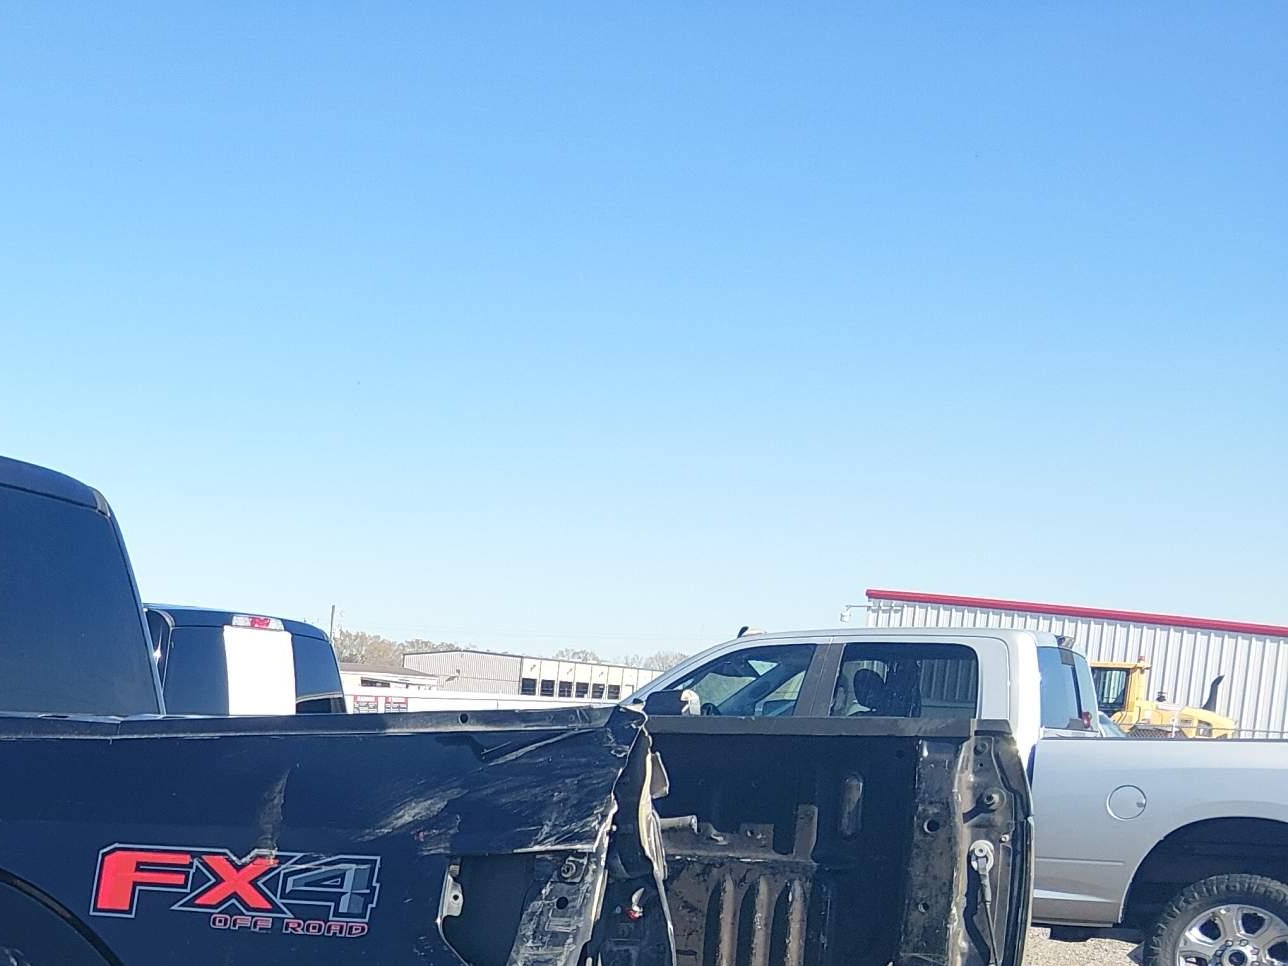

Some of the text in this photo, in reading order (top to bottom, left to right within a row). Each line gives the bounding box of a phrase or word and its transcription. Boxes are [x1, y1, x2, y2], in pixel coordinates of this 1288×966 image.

[89, 842, 381, 923] FX4
[209, 914, 369, 938] OFF ROAD
